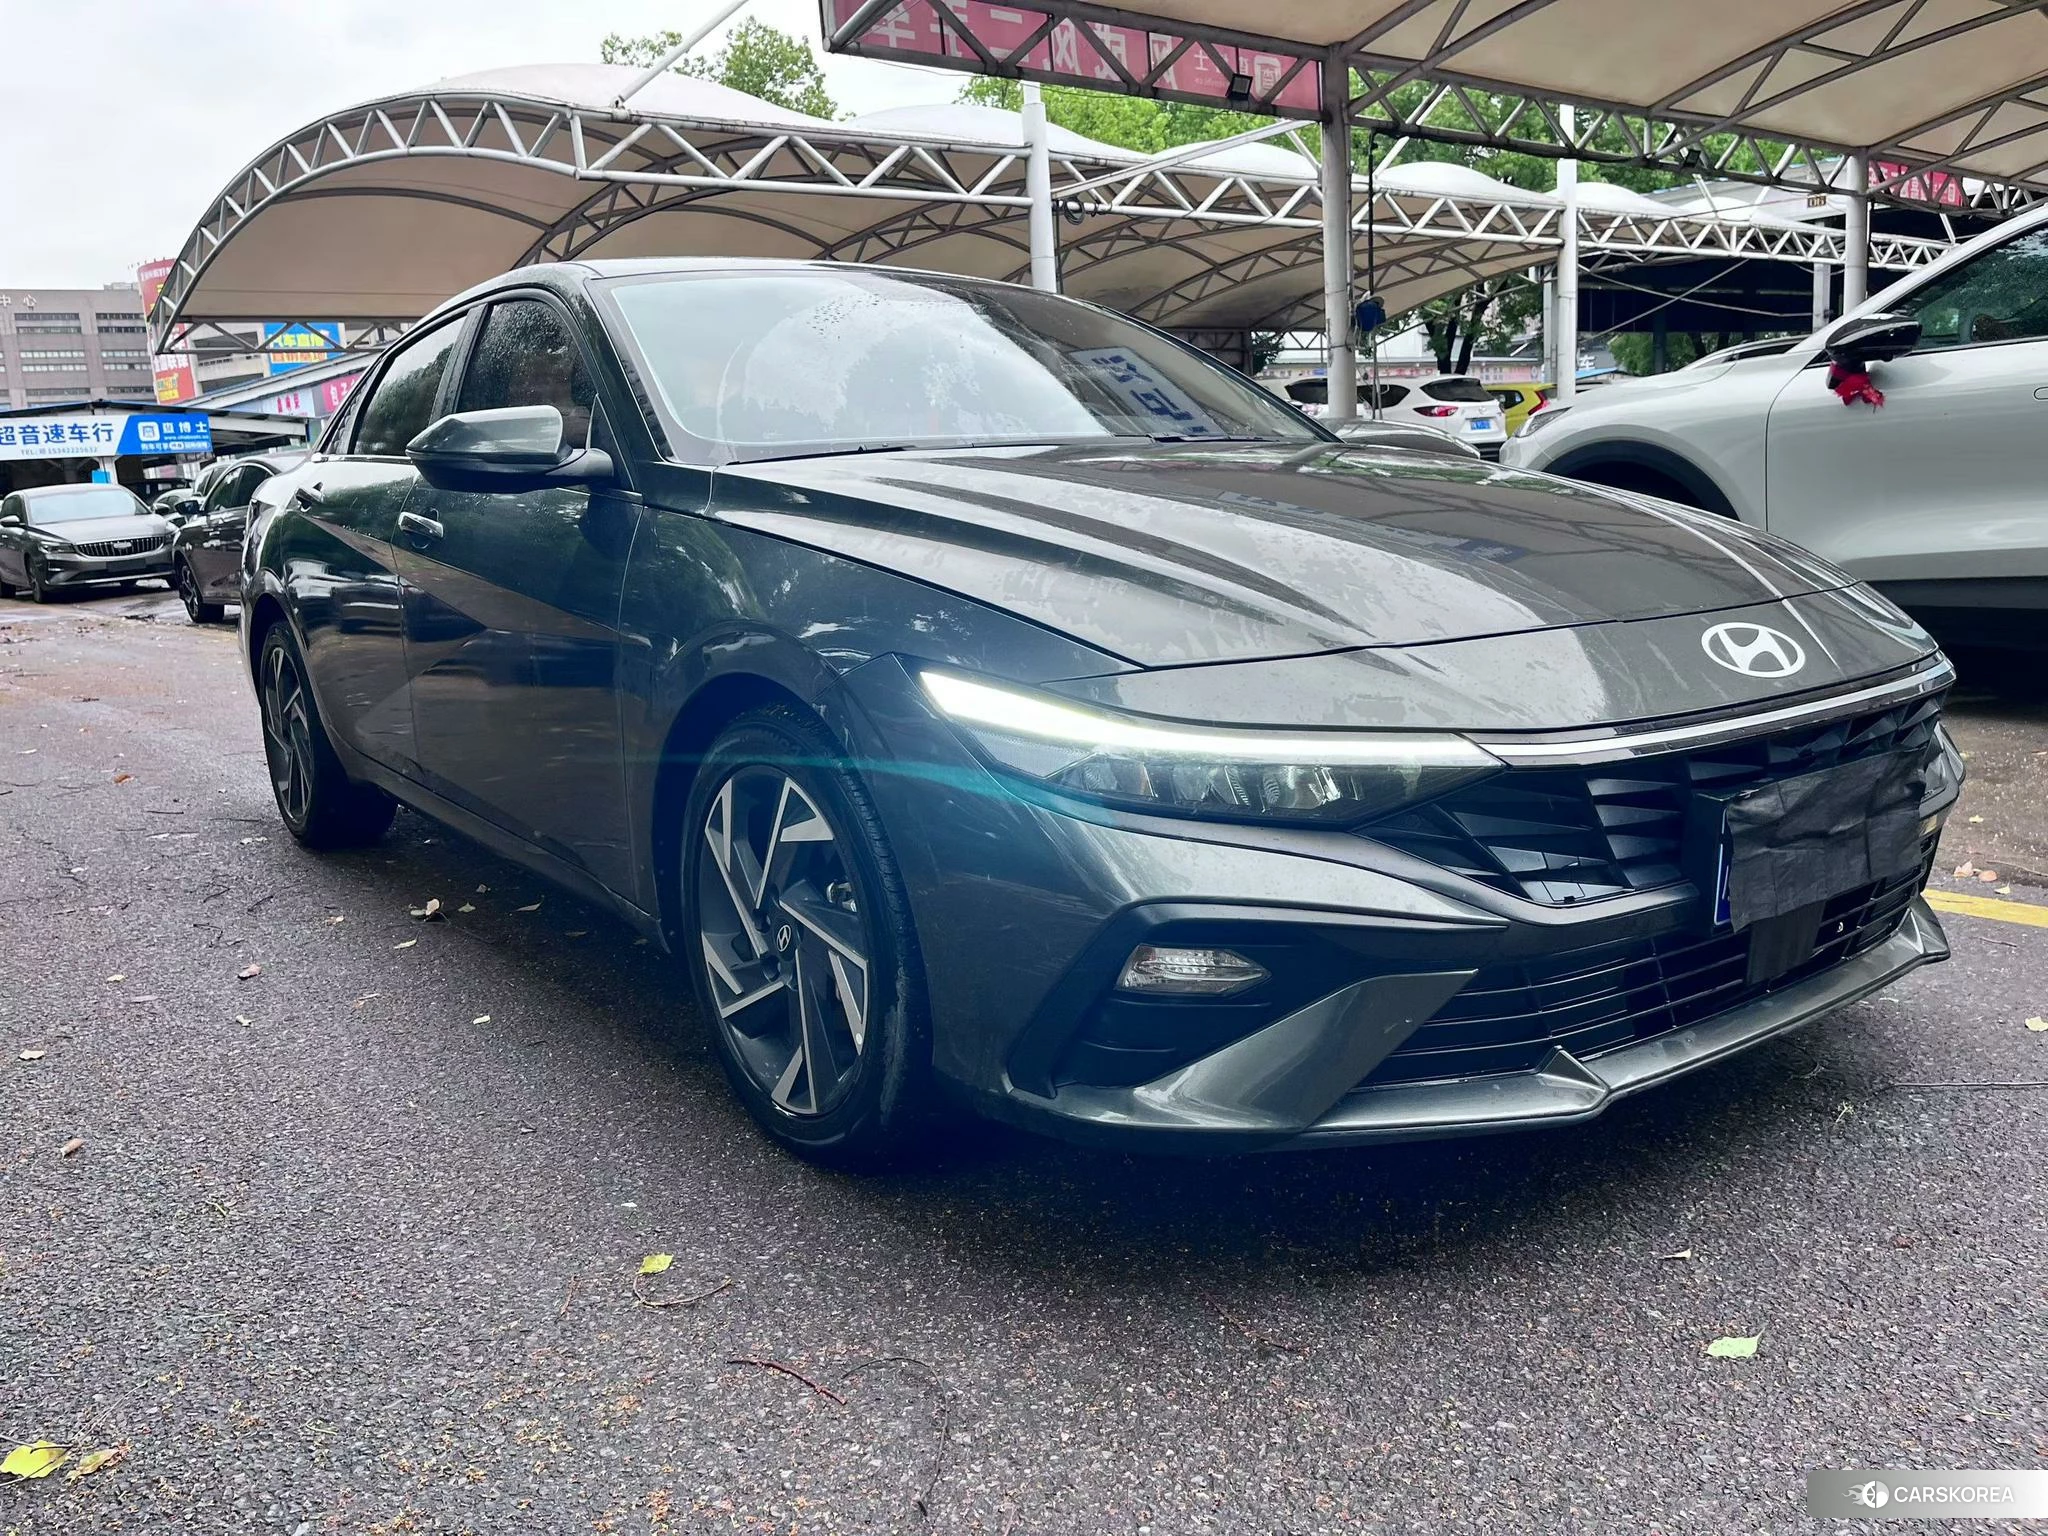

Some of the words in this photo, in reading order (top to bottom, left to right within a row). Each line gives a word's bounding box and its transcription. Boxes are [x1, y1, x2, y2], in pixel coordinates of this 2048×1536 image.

[0, 422, 113, 445] 超音速车行
